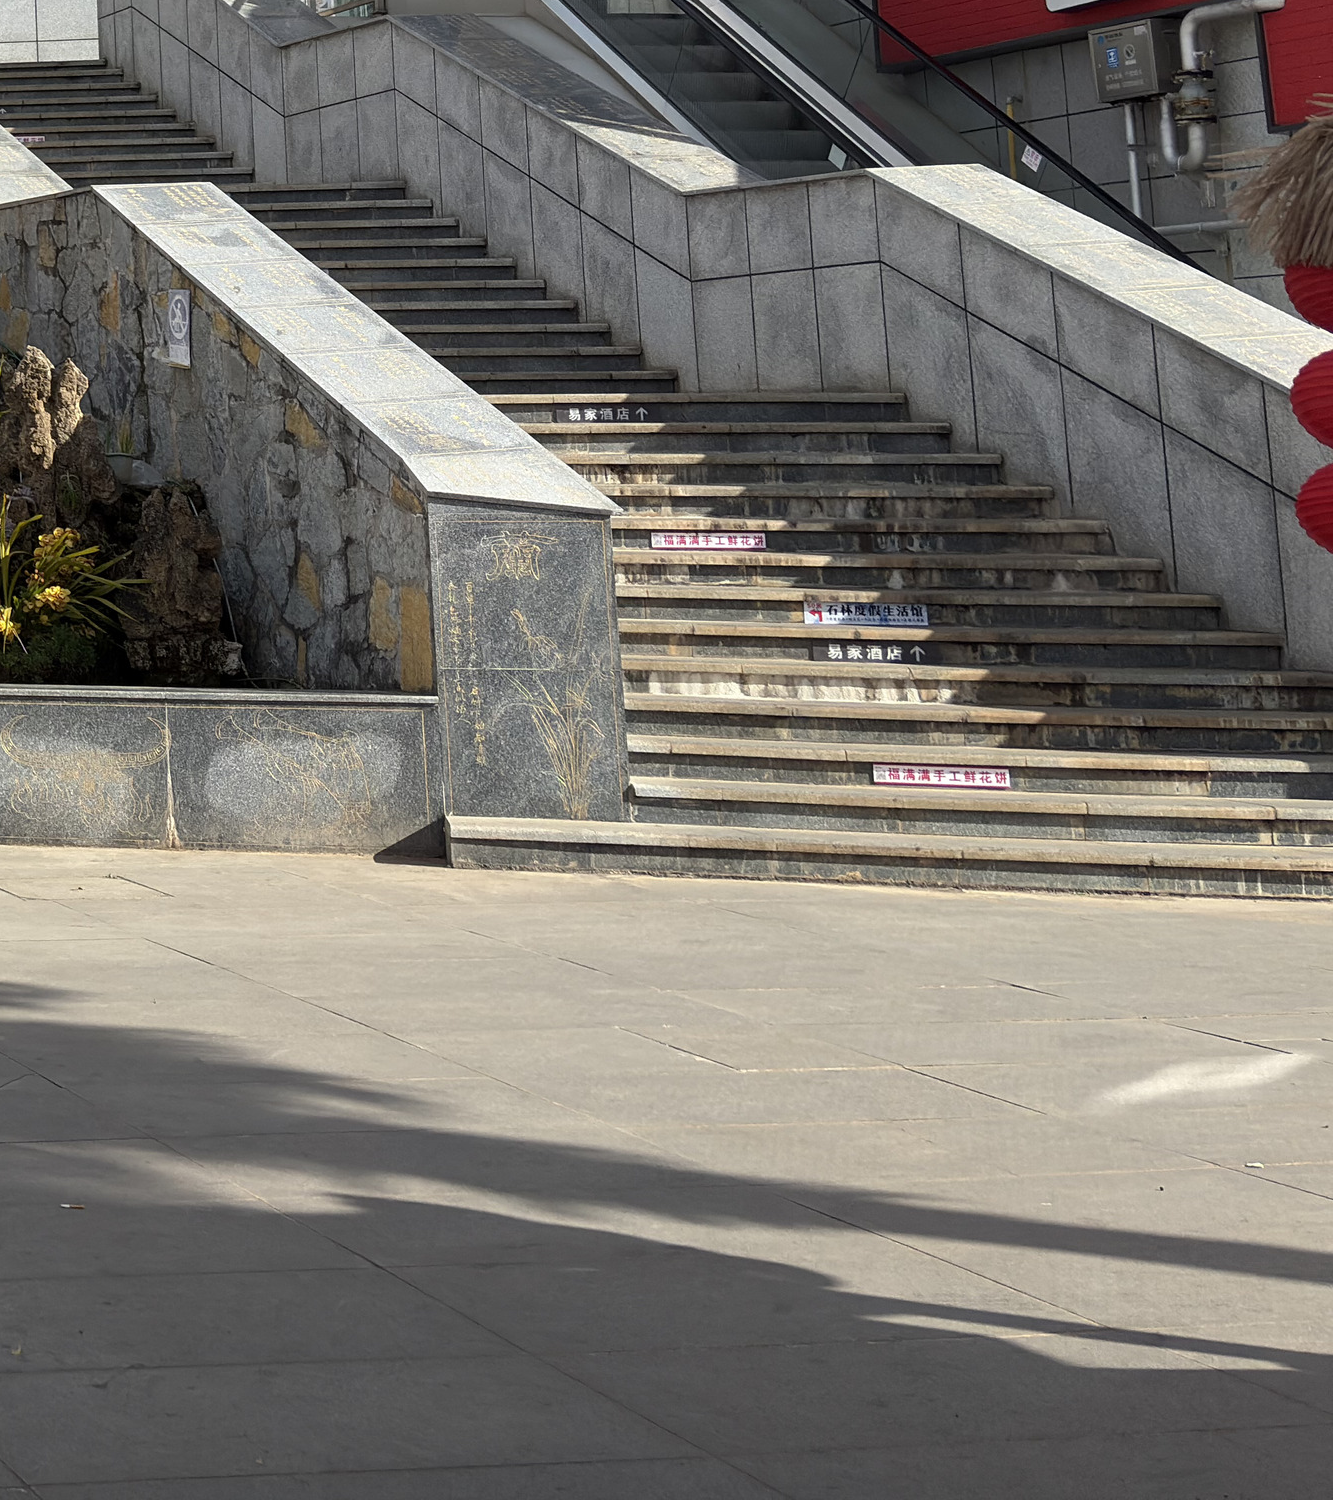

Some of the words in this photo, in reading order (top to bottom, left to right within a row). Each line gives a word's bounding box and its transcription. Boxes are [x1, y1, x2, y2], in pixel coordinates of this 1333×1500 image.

[568, 407, 630, 421] 易家酒店
[663, 534, 764, 547] 福满满手工鲜花饼
[826, 603, 924, 617] 石林度假生活馆
[827, 643, 902, 661] 易家酒店
[888, 767, 1008, 785] 福满满手工鲜花饼
